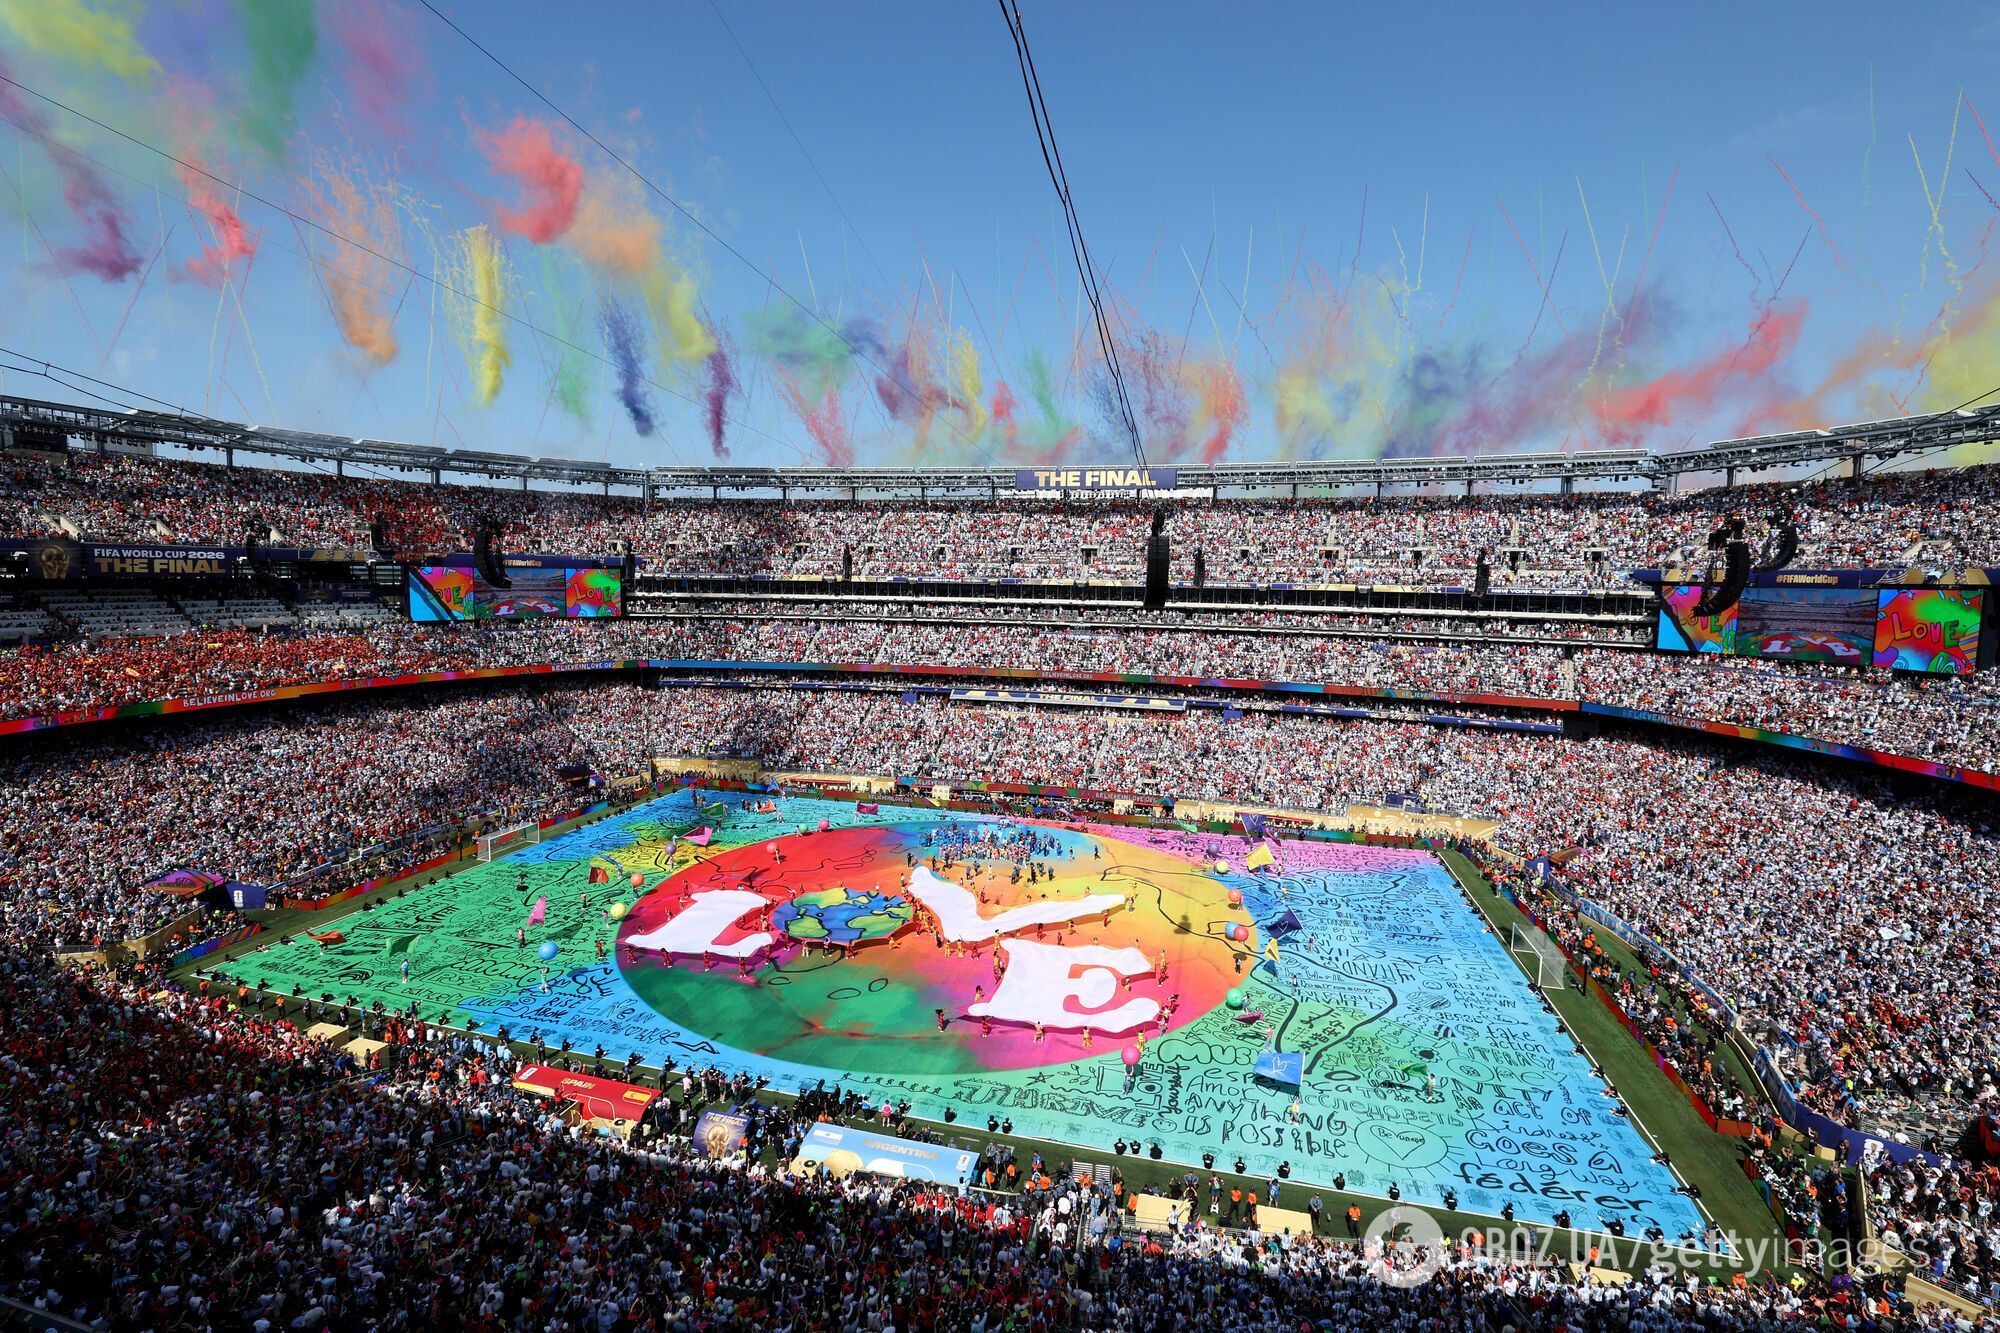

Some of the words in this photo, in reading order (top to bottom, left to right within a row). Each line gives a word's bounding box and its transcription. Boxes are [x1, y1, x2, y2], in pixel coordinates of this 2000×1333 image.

[1034, 471, 1081, 487] THE
[1085, 470, 1157, 487] FINAL
[94, 549, 121, 557] FIFA
[122, 549, 164, 559] WORLD
[165, 551, 186, 559] CUP
[188, 551, 225, 559] 2026
[94, 558, 148, 574] THE
[153, 559, 226, 574] FINAL
[1776, 574, 1839, 586] #FIFAWorldCup
[574, 583, 612, 603] LOVE
[1890, 611, 1960, 649] LOVE
[551, 662, 617, 672] BELIEVEINLOVE.ORG
[182, 690, 277, 708] BELIEVEINLOVE.ORG
[1622, 710, 1707, 731] BELIEVEINLOVE.ORG
[1411, 817, 1425, 825] FIFA
[1333, 926, 1346, 935] BY
[1350, 928, 1374, 937] LOVE
[1445, 981, 1499, 992] BELIEVE
[1487, 1025, 1536, 1042] take
[1486, 1035, 1550, 1055] action
[1353, 1064, 1411, 1083] YOU
[560, 1077, 596, 1090] SPAIN
[1134, 1061, 1165, 1111] LOVE
[1186, 1075, 1257, 1100] Amor
[953, 1077, 1153, 1129] THRIVE
[705, 1114, 722, 1124] THE
[722, 1116, 745, 1127] FINAL
[863, 1139, 938, 1160] ARGENTINA
